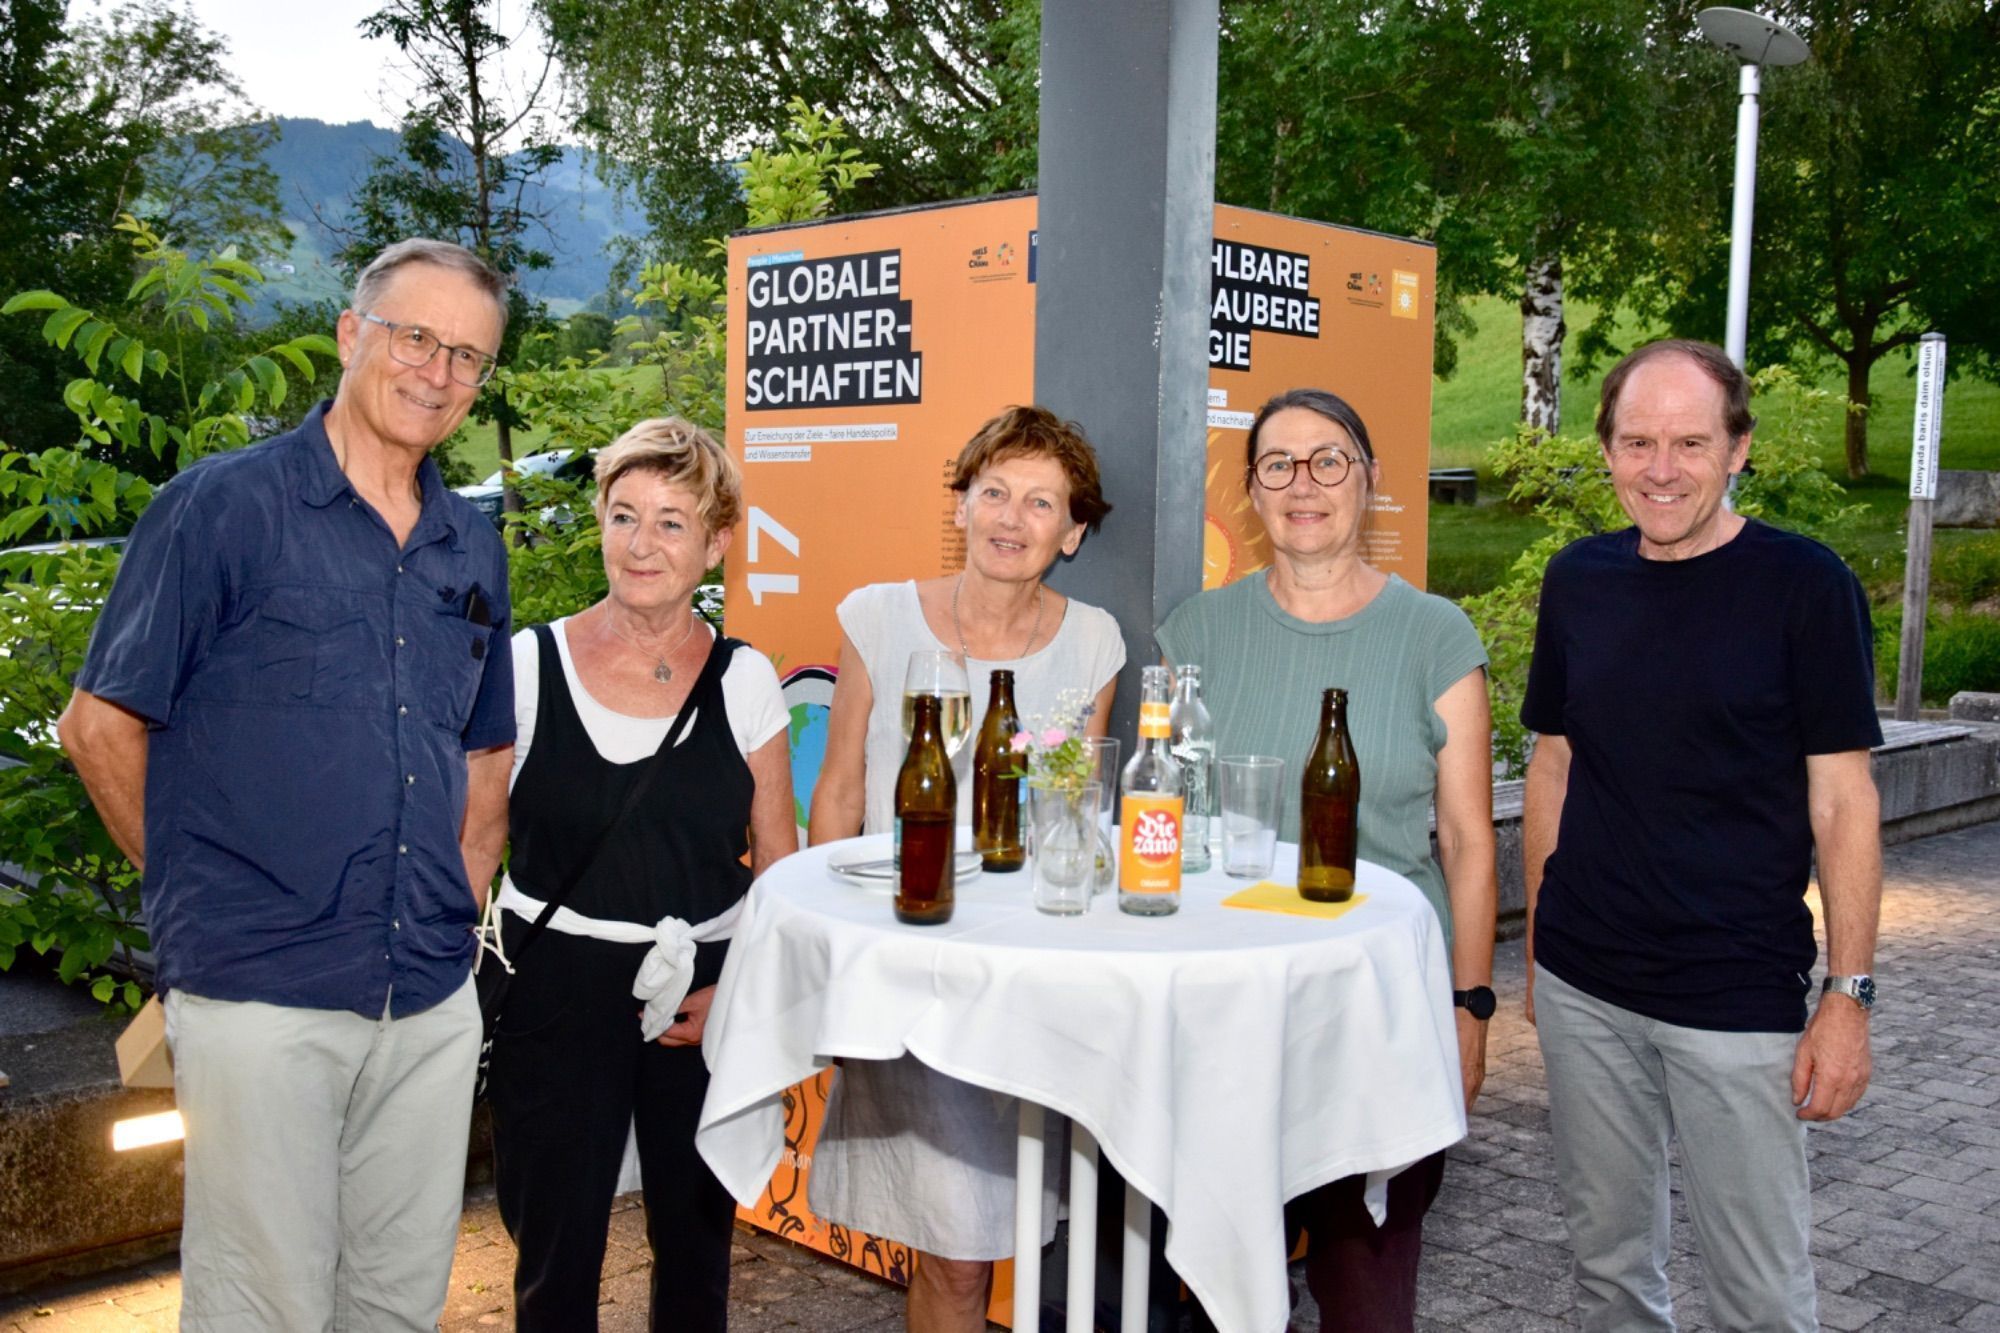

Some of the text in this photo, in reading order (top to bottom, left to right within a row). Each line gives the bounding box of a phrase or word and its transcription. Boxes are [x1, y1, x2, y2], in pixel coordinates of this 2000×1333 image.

[748, 255, 900, 308] GLOBALE
[1210, 244, 1309, 290] HLBARE
[748, 308, 912, 356] PARTNER-
[1210, 288, 1320, 333] AUBERE
[1208, 330, 1250, 366] GIE
[746, 358, 920, 404] SCHAFTEN
[846, 426, 896, 440] Handelspolitik
[747, 506, 800, 606] 17
